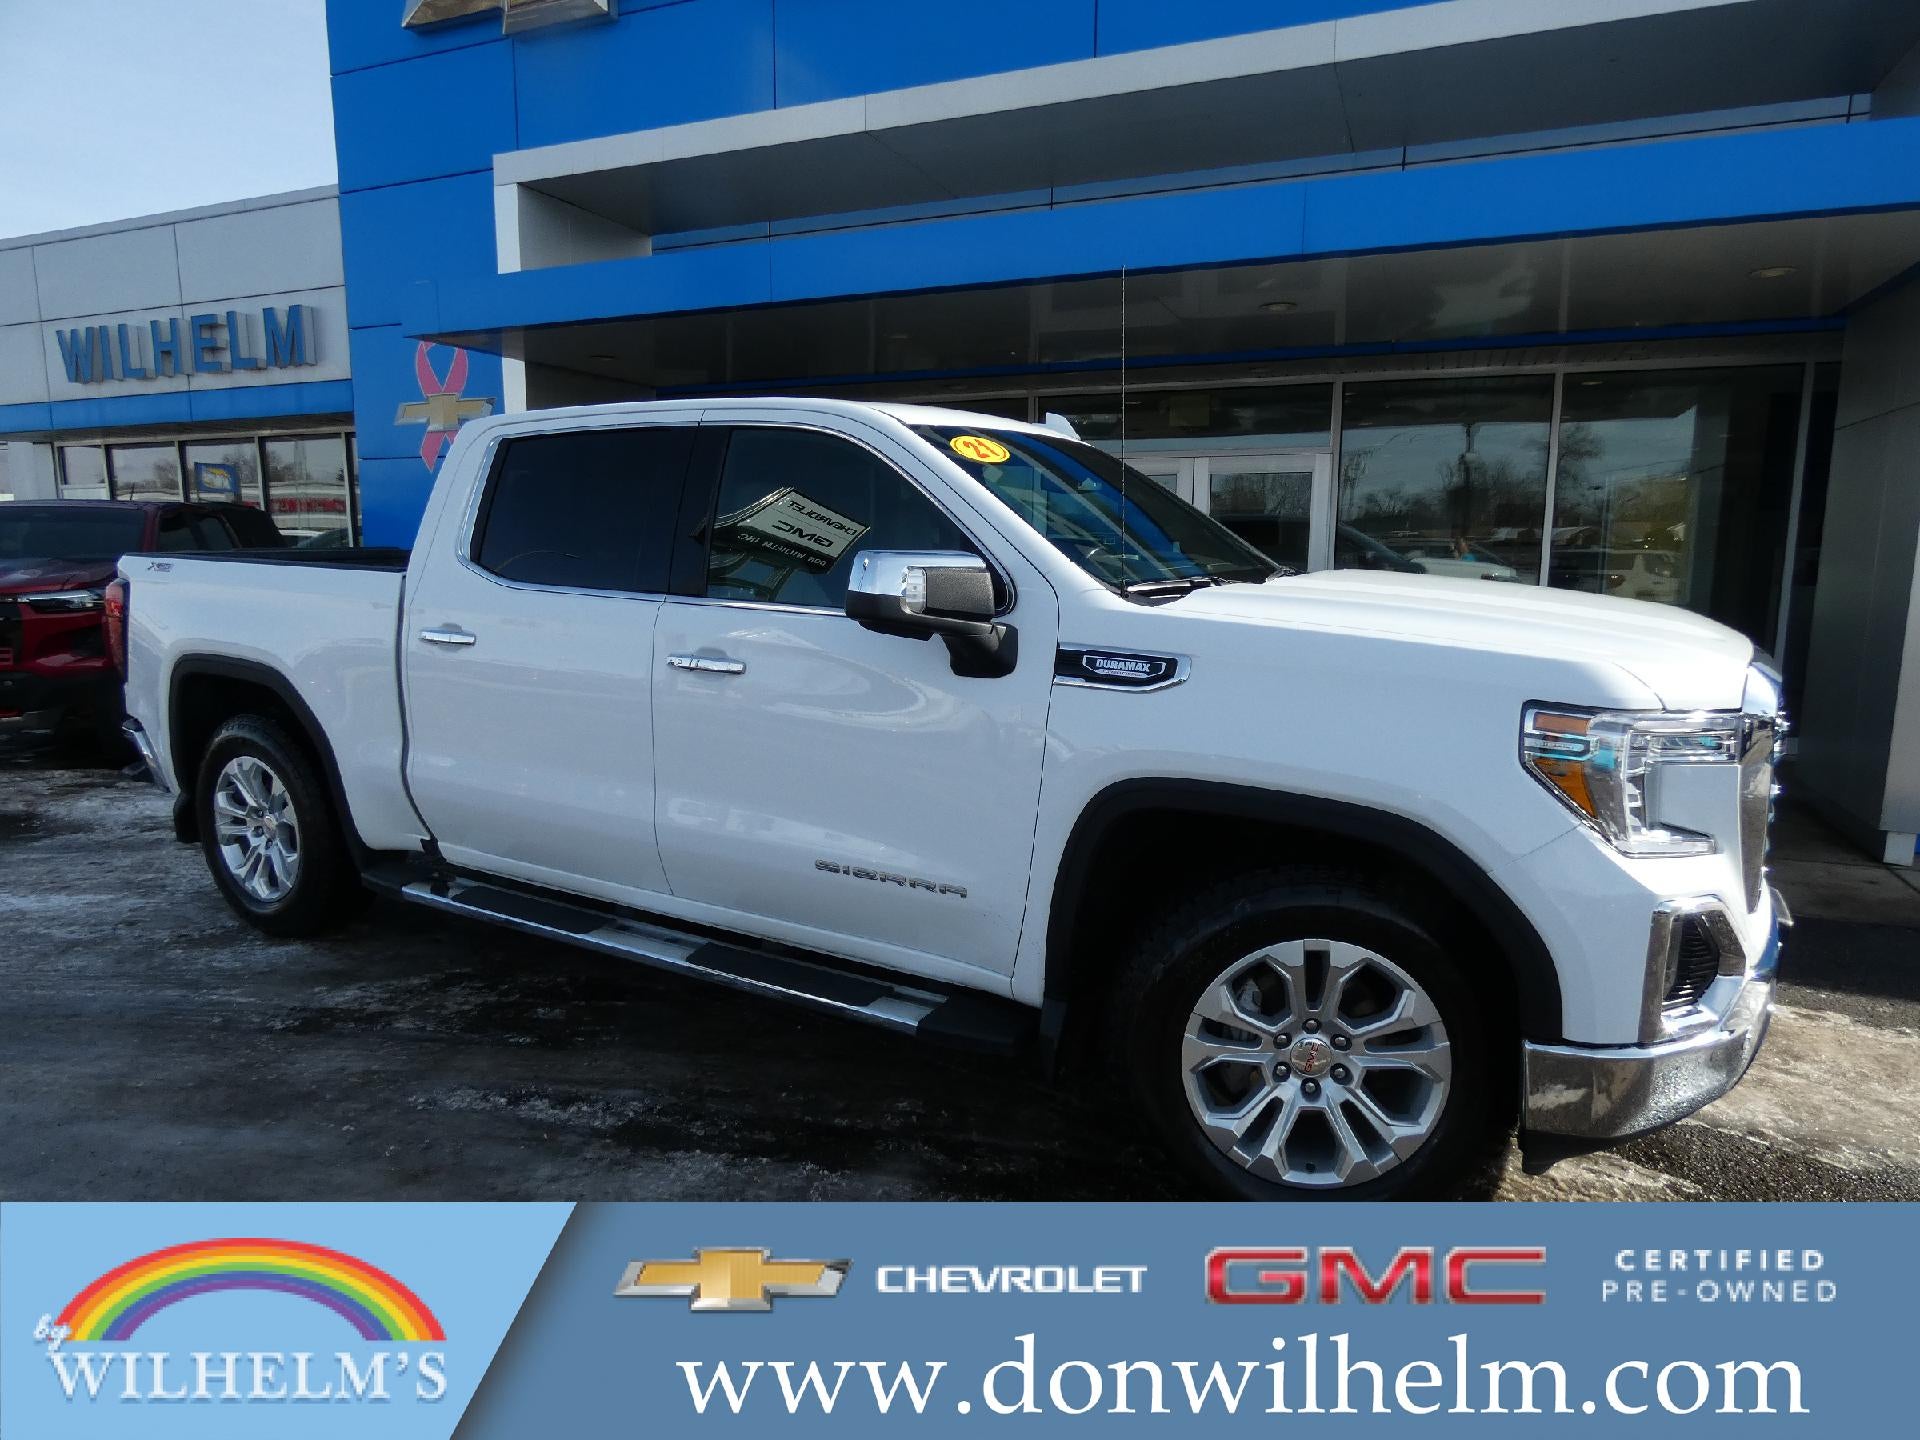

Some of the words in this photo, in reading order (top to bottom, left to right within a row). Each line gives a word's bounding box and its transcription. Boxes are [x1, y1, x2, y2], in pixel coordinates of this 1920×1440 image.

[55, 304, 317, 384] WILHELM
[963, 438, 1000, 459] 21
[1095, 658, 1151, 673] DURAMAX
[814, 858, 968, 899] SIERRA
